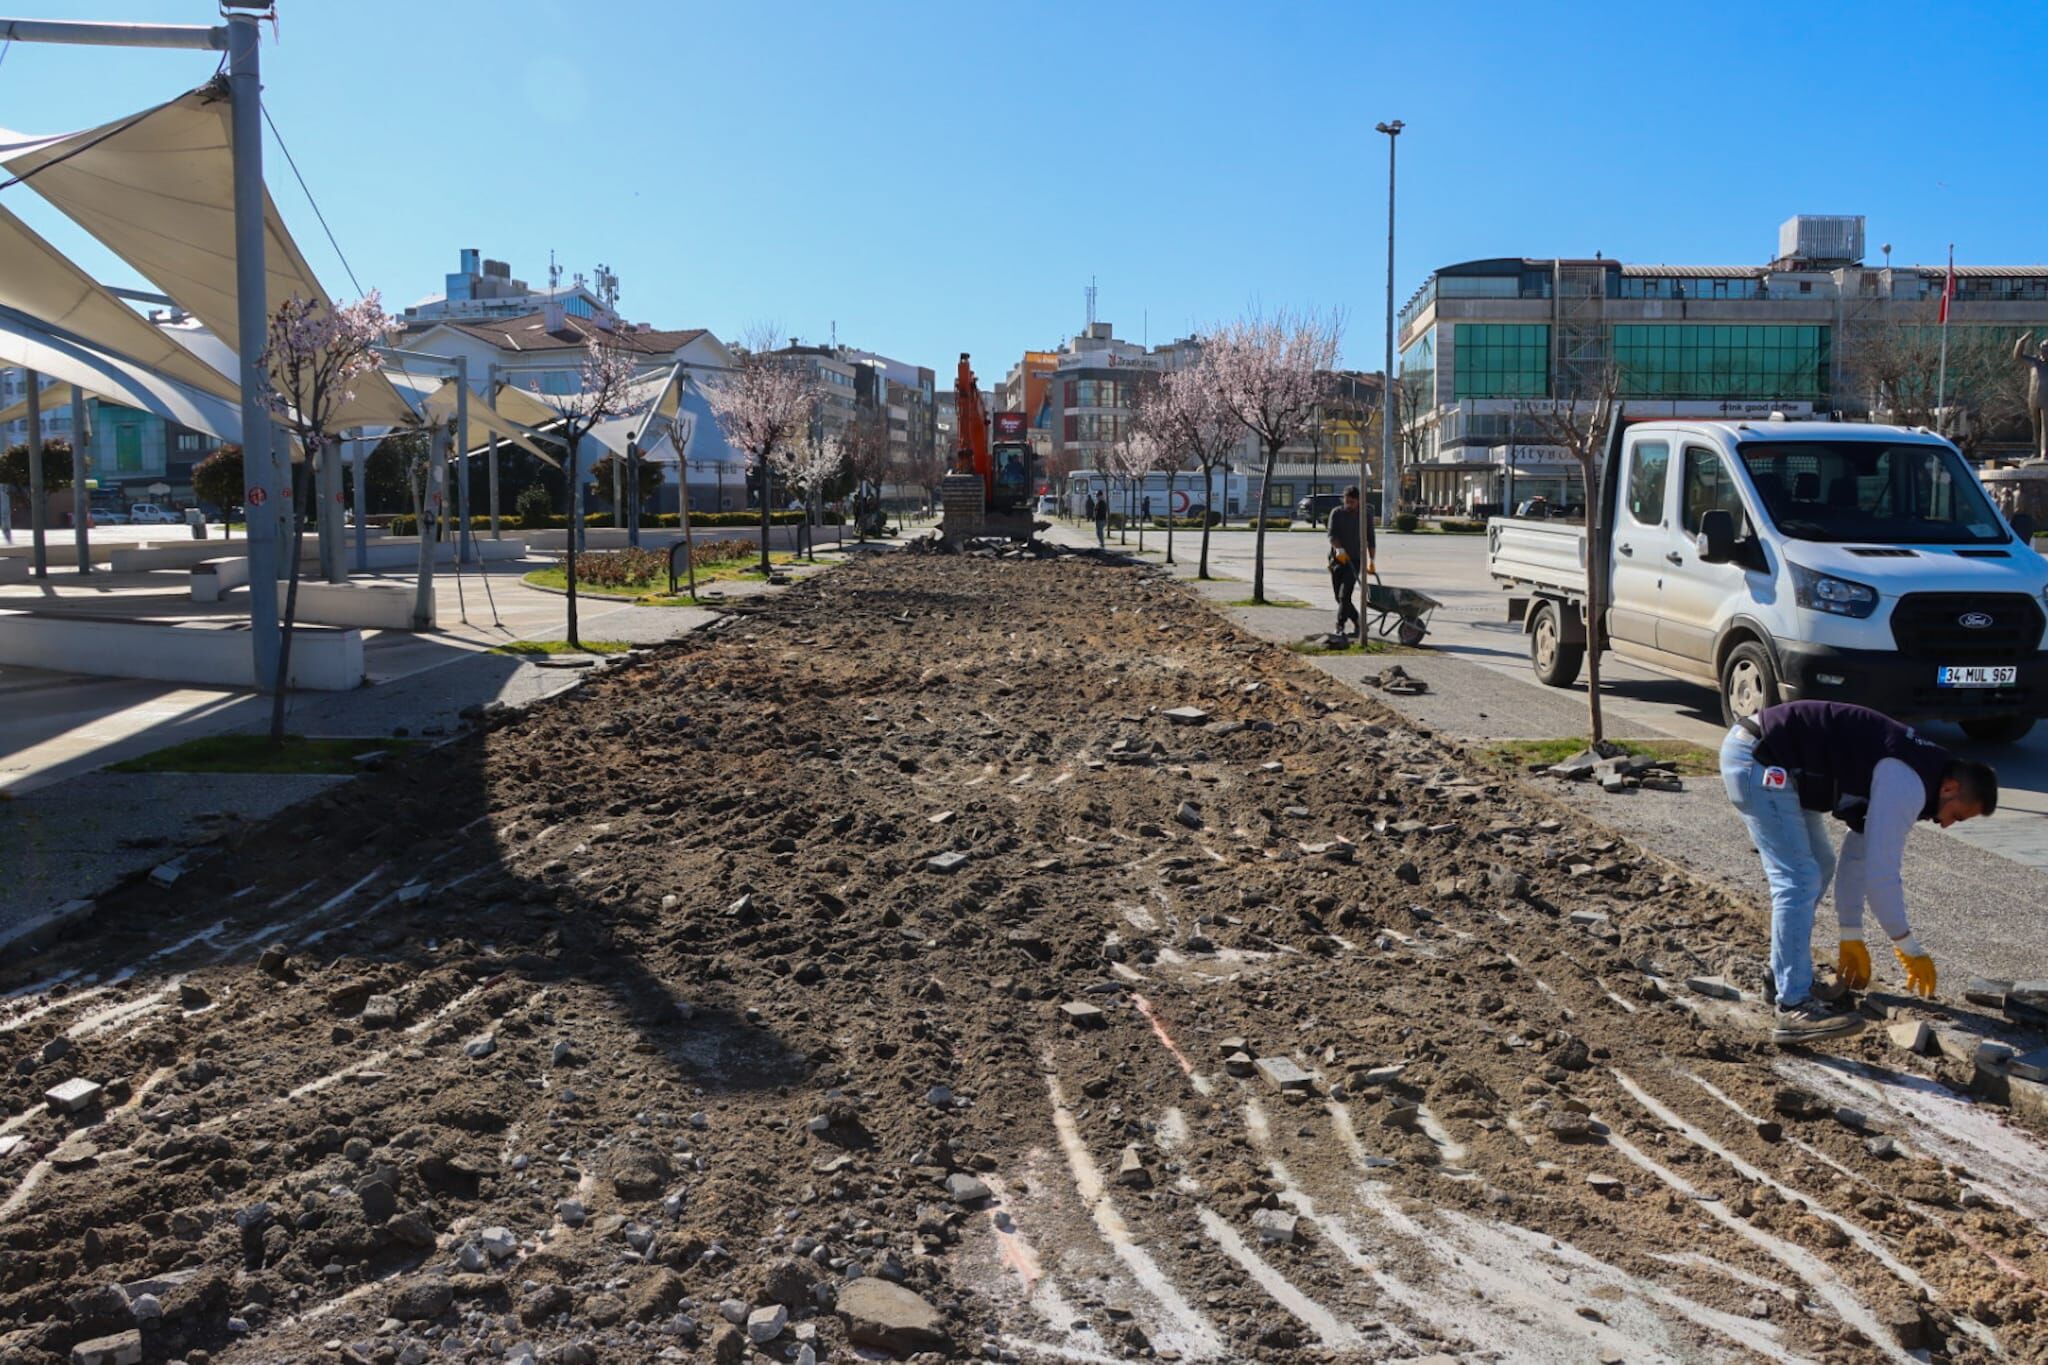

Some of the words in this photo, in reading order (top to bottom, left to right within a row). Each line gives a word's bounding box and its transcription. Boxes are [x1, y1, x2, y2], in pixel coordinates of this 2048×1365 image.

[1719, 403, 1742, 411] drink
[1745, 403, 1768, 413] good
[1771, 403, 1798, 412] coffee
[1965, 615, 1987, 625] Ford
[1946, 668, 1961, 682] 34
[1965, 668, 1987, 682] MUL
[1992, 668, 2014, 682] 967
